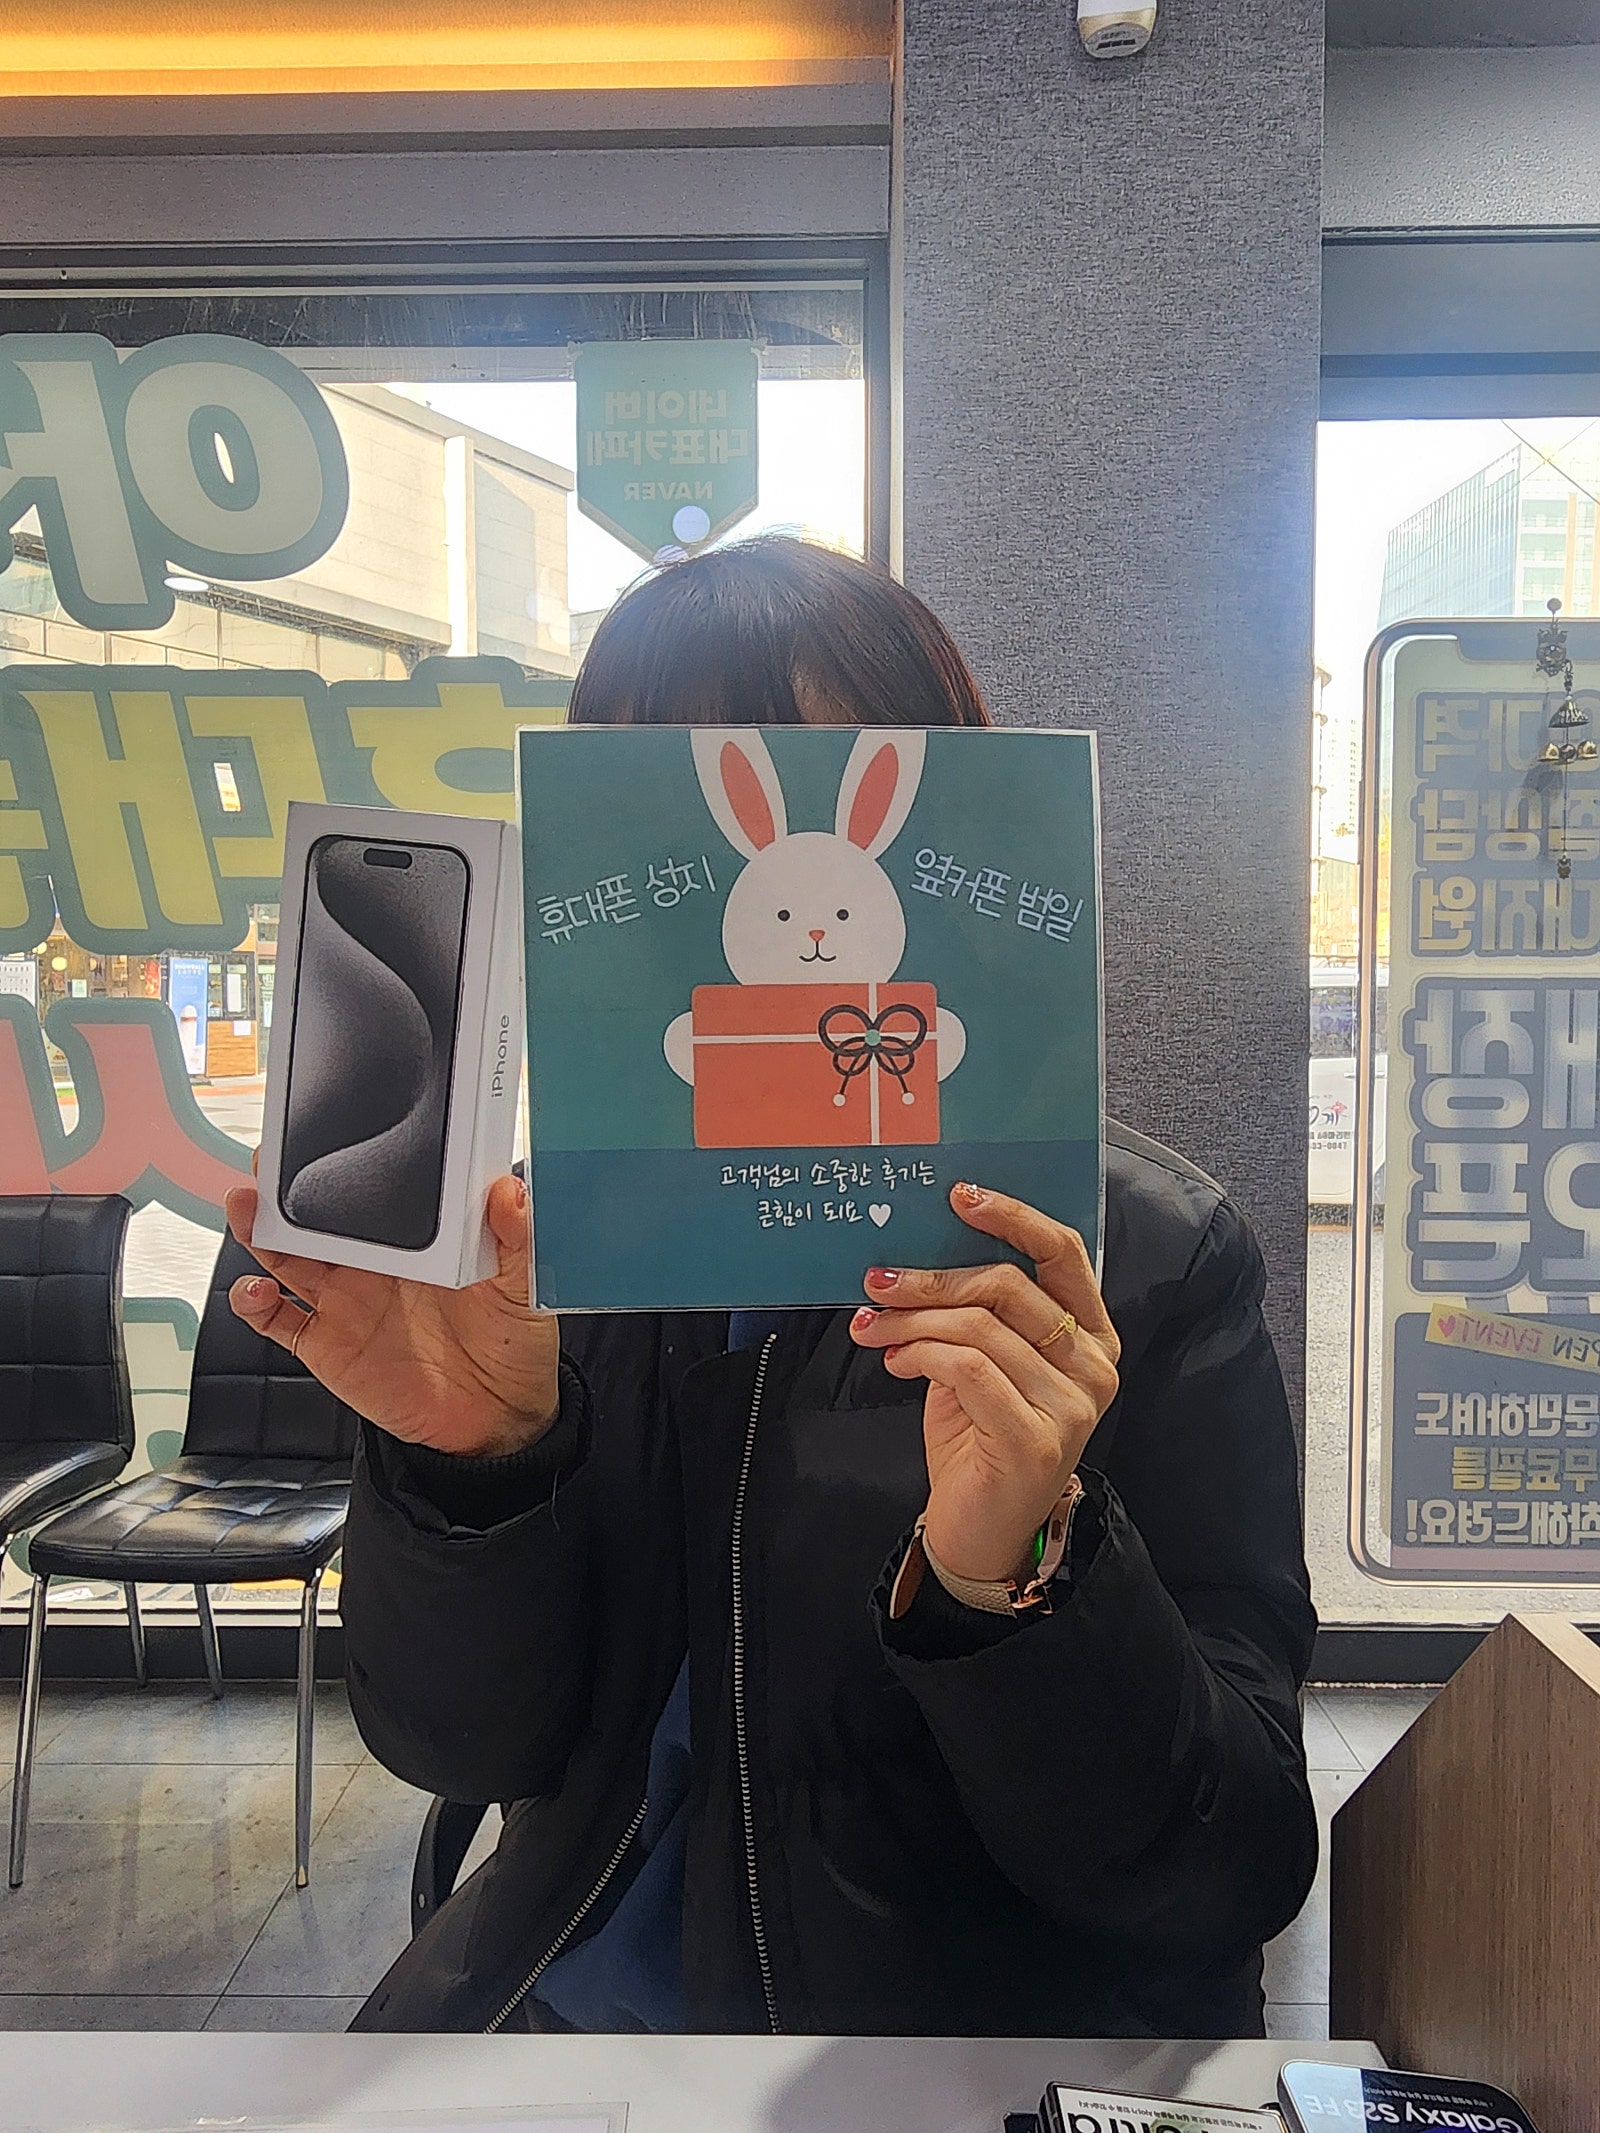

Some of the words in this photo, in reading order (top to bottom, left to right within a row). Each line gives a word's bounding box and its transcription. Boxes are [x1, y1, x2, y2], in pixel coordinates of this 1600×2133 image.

[536, 873, 642, 944] 휴대폰
[645, 855, 716, 908] 성지
[910, 848, 1012, 918] 옆커폰
[1017, 881, 1083, 943] 범일
[491, 1015, 510, 1097] iPhone
[720, 1163, 800, 1190] 고객님의
[810, 1158, 873, 1193] 소중한
[881, 1157, 936, 1190] 후기는
[757, 1199, 812, 1229] 큰힘이
[822, 1200, 863, 1223] 되요
[1303, 2094, 1341, 2117] FE
[1343, 2099, 1399, 2123] S23
[1406, 2101, 1523, 2133] Galaxy
